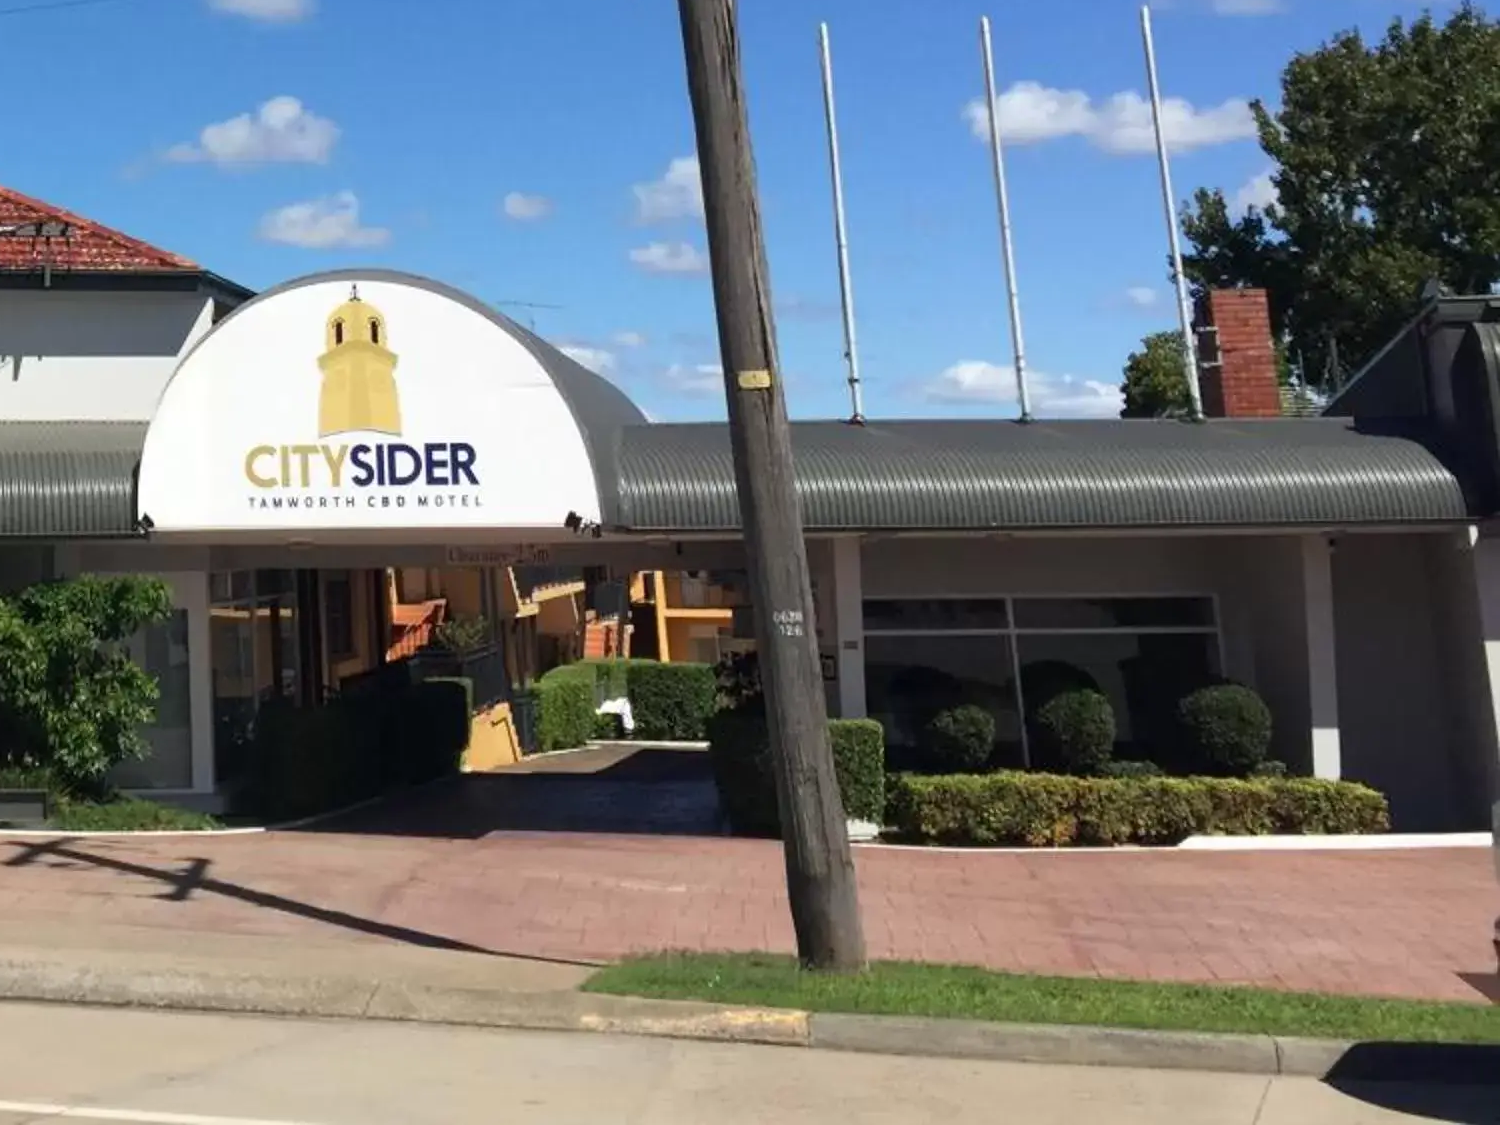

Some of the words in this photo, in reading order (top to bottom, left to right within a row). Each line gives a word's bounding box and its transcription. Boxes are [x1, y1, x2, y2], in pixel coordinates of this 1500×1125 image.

[244, 442, 480, 489] CITYSIDER
[248, 496, 356, 509] TAMWORTH
[367, 495, 406, 508] CBD
[417, 494, 484, 508] MOTEL
